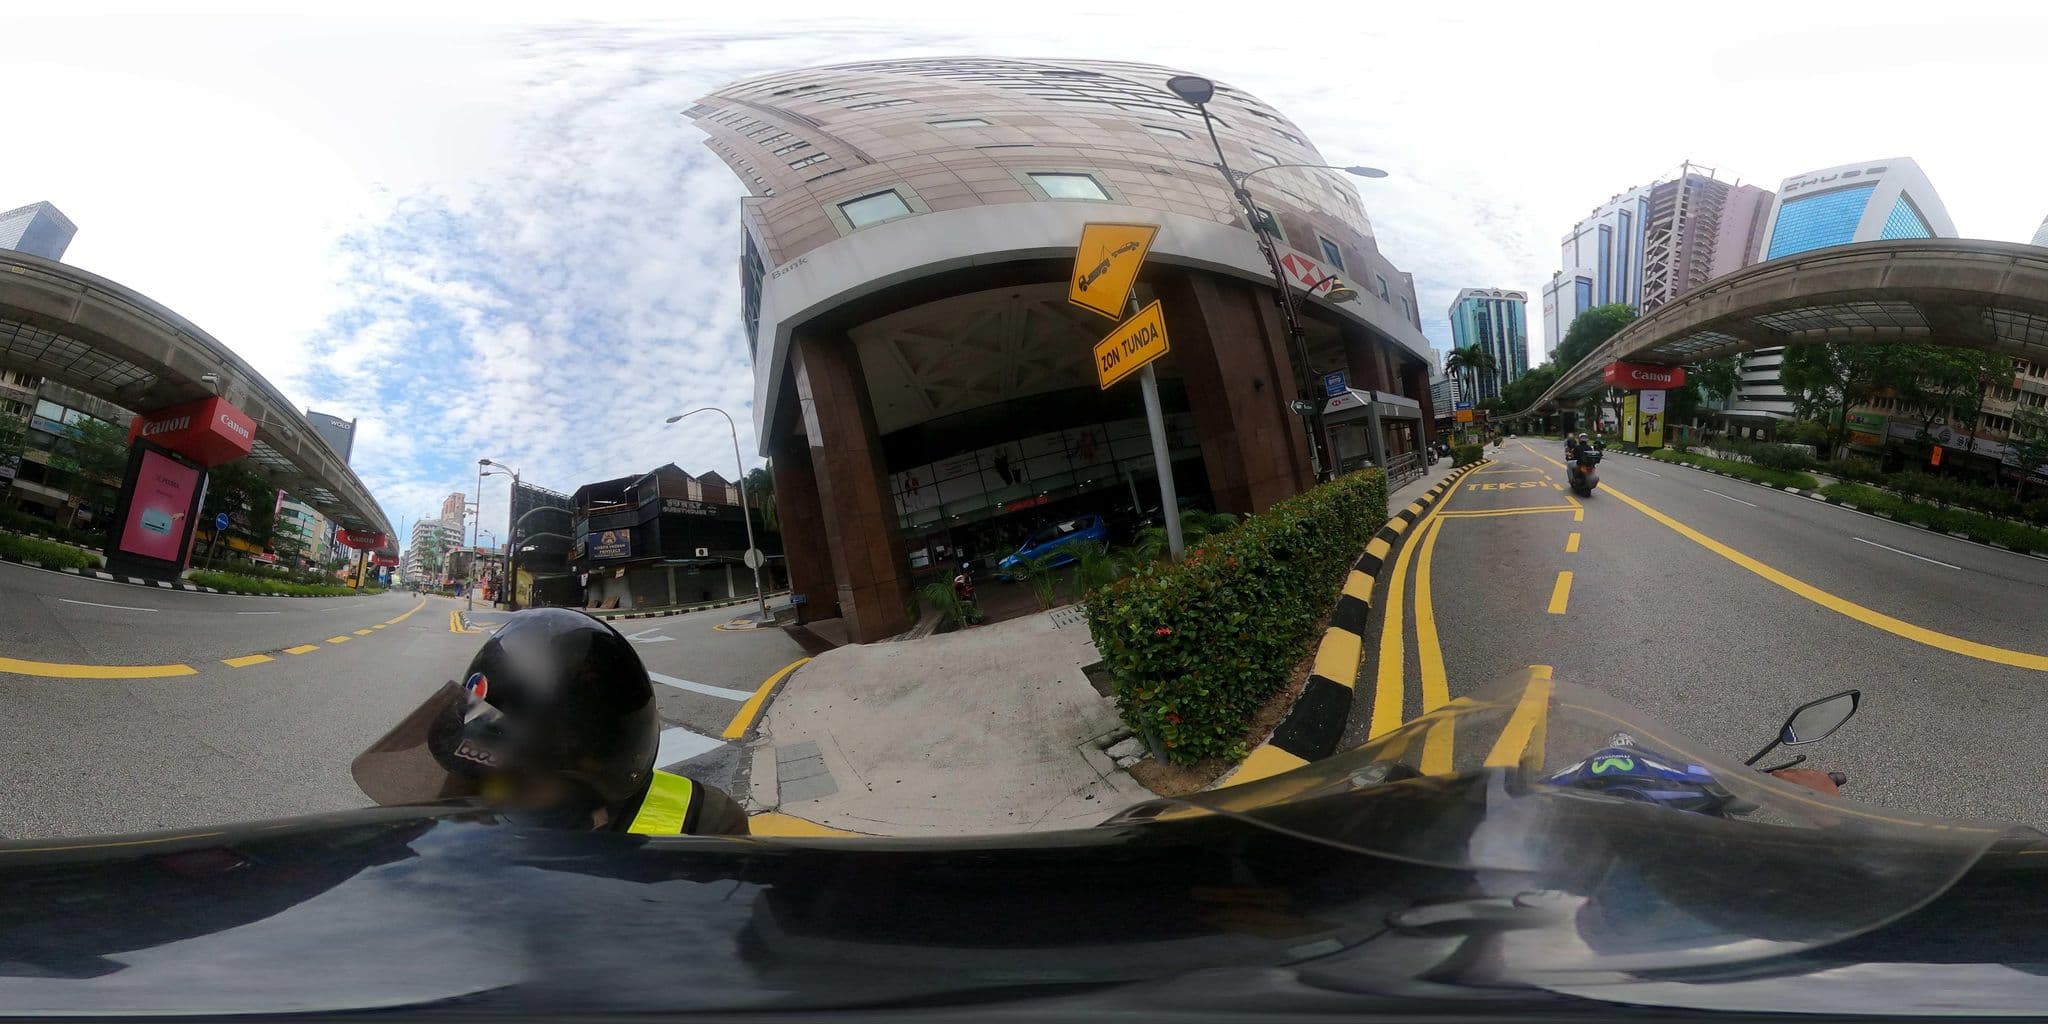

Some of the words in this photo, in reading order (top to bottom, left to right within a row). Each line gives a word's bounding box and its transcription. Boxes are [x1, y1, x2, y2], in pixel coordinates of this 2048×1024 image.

[771, 257, 808, 280] Bank
[1101, 346, 1120, 373] ZON
[1121, 322, 1159, 358] TUNDA
[1631, 369, 1672, 383] Canon
[142, 416, 190, 436] Canon
[220, 414, 249, 439] Canon
[331, 420, 350, 429] WOLO
[1467, 480, 1547, 491] TEKSI
